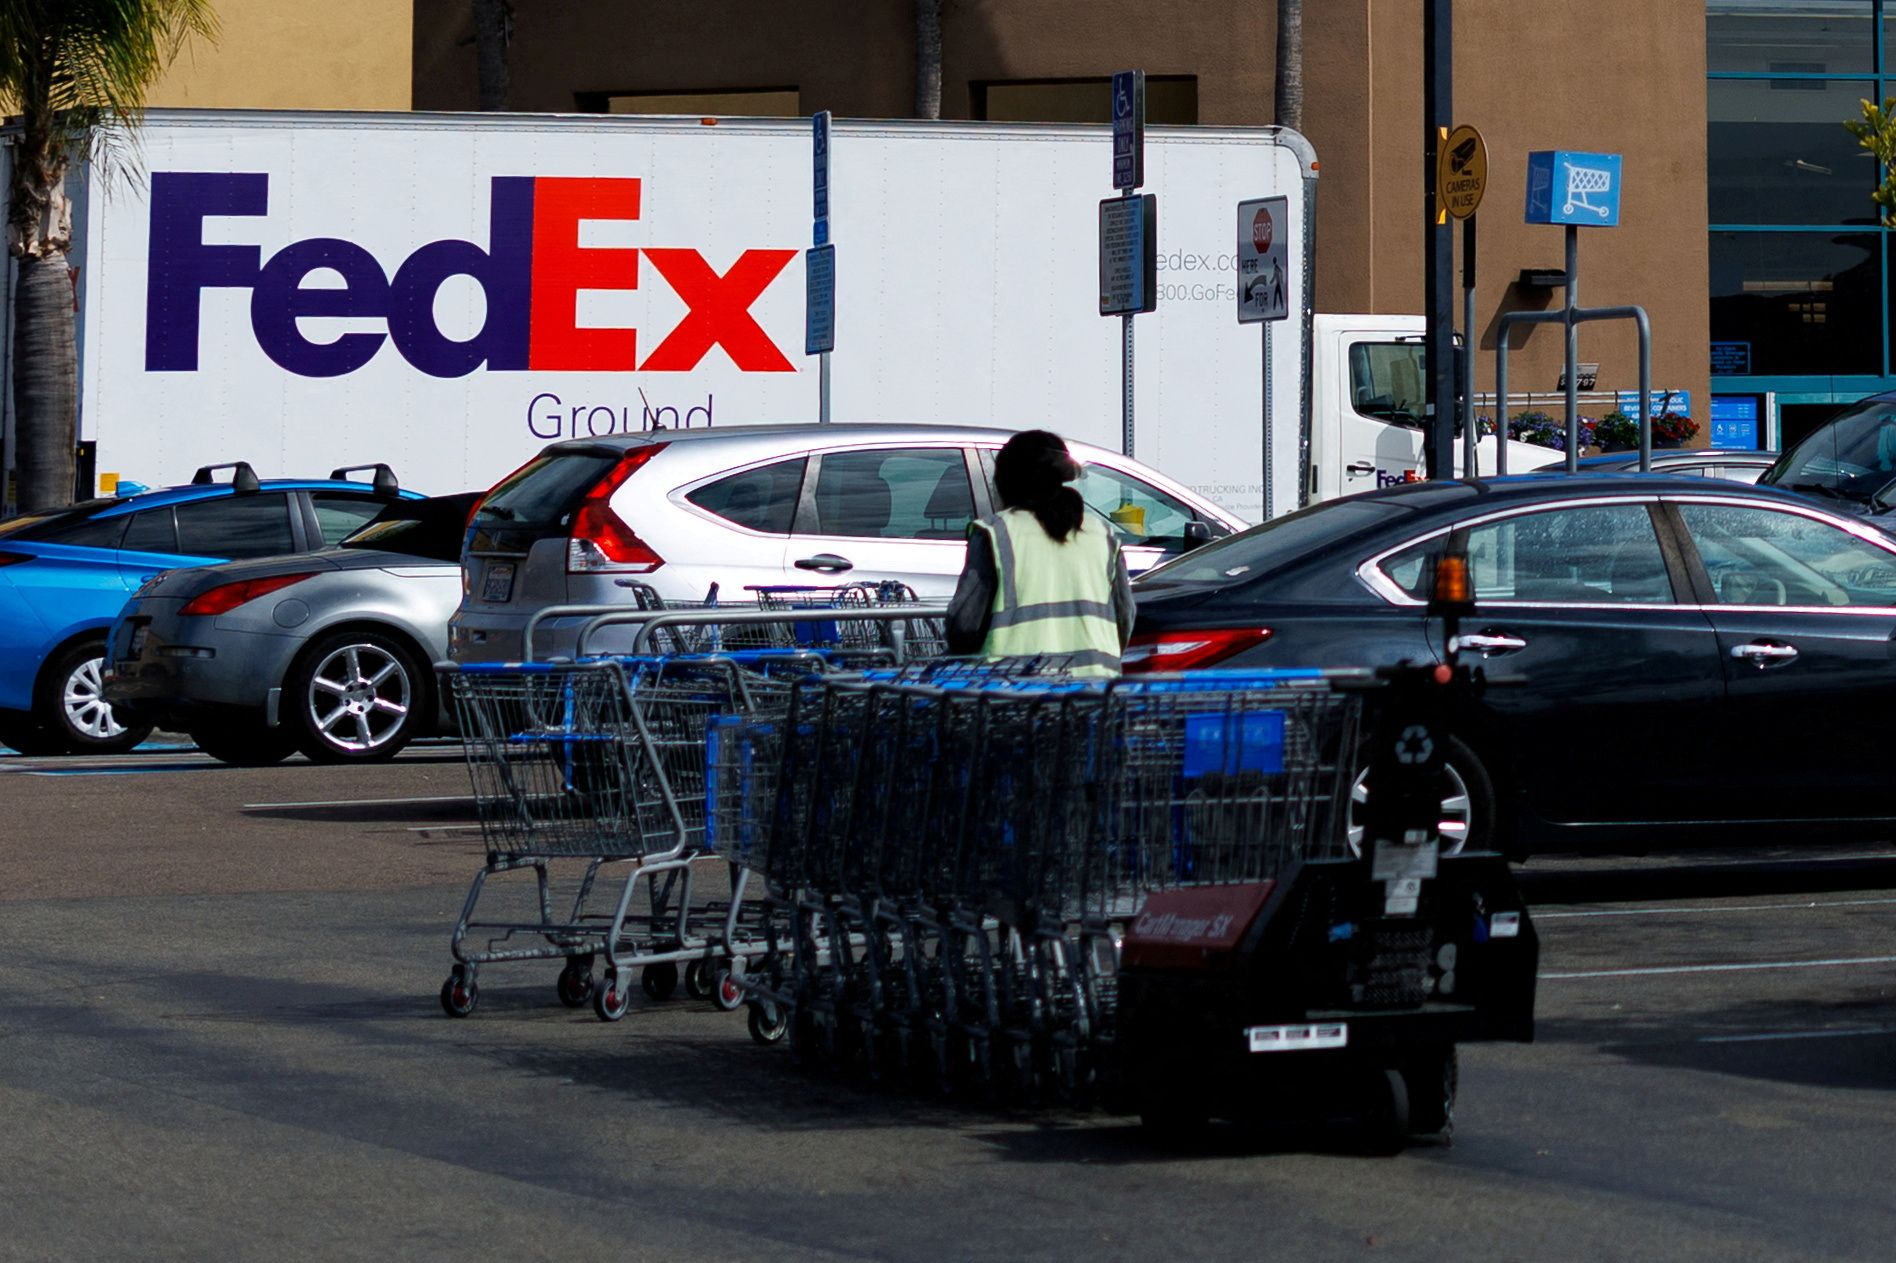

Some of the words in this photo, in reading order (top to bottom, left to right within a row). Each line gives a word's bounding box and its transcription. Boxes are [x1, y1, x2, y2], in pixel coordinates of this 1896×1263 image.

[1446, 178, 1480, 194] CAMERAS
[1452, 196, 1460, 208] IN
[1461, 194, 1474, 206] USE
[1254, 222, 1271, 241] STOP
[1156, 248, 1238, 271] edex.c
[1242, 258, 1259, 274] HERE
[145, 172, 800, 379] FedEx
[1156, 283, 1238, 301] 800.GoFe
[1255, 292, 1269, 308] FOR
[527, 392, 713, 439] Ground
